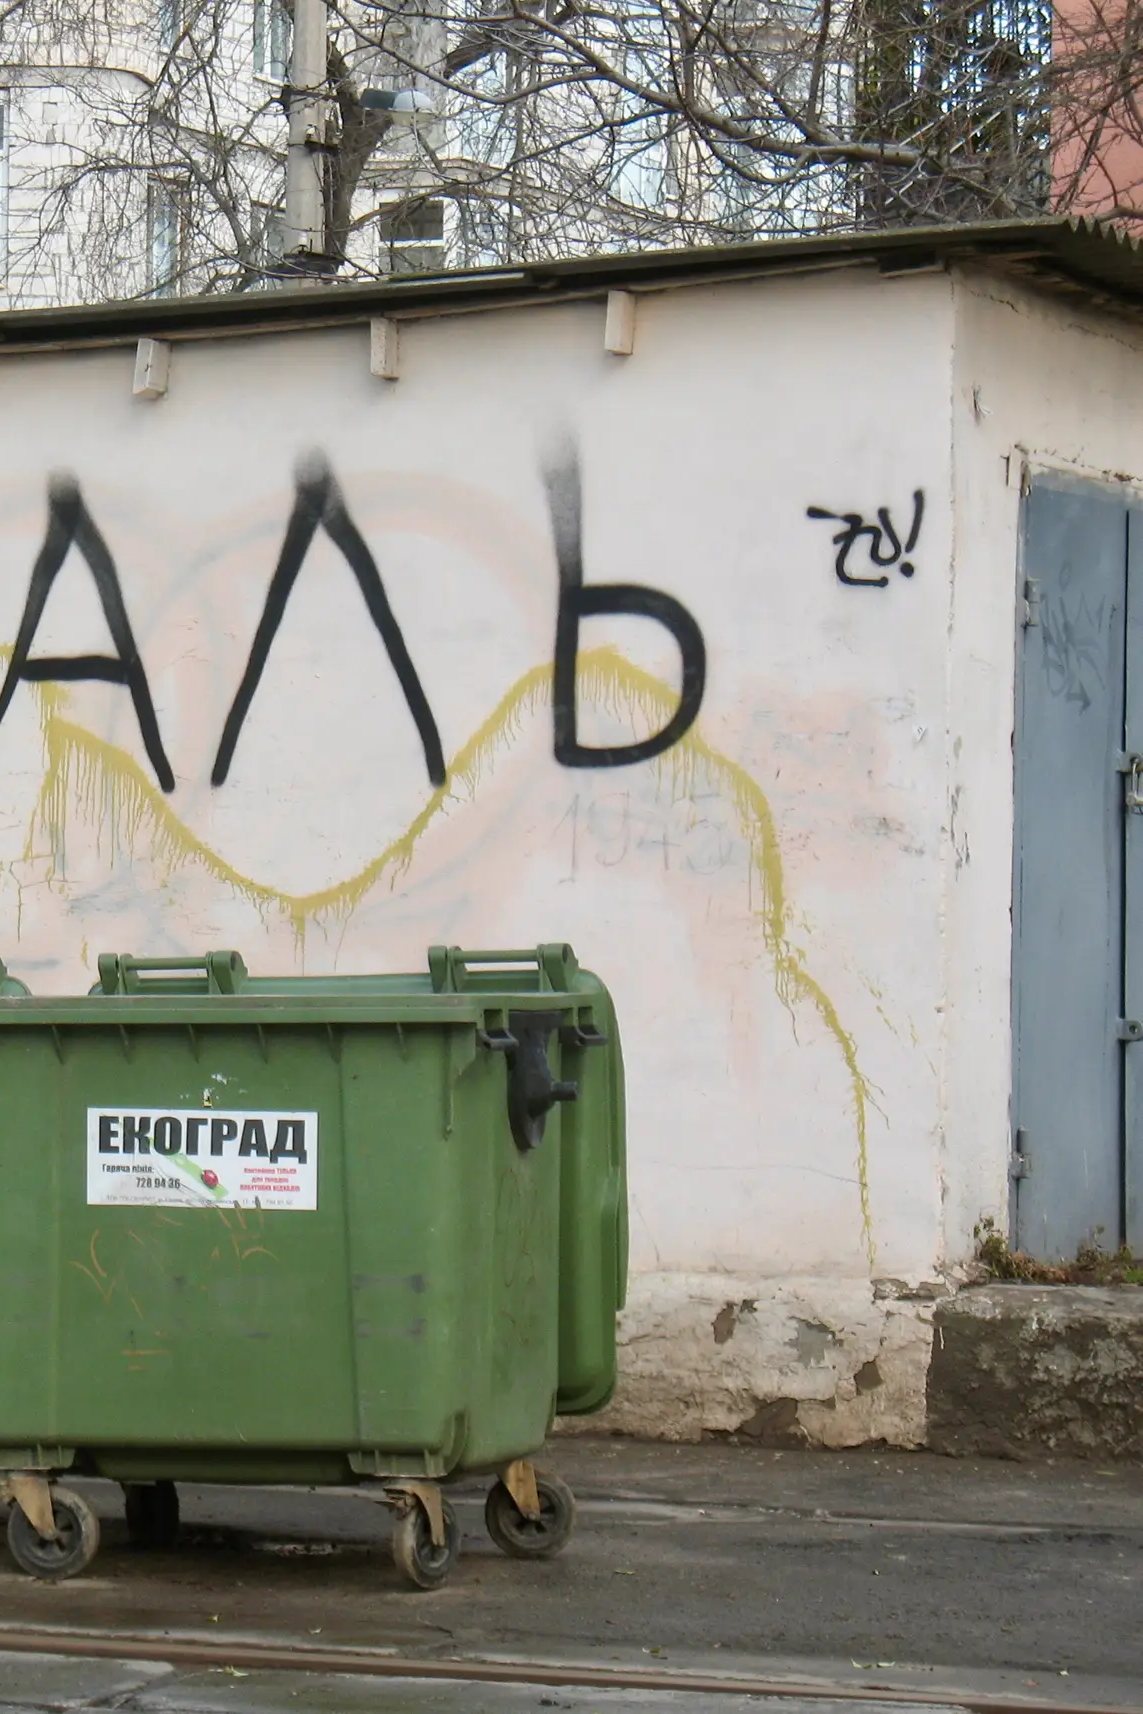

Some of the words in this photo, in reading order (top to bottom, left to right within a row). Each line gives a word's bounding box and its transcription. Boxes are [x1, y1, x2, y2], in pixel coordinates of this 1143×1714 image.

[98, 1115, 308, 1165] ЕКОГРАД
[101, 1163, 131, 1174] Гаряча
[136, 1177, 152, 1189] 728
[154, 1178, 167, 1189] 94
[168, 1178, 181, 1190] 36
